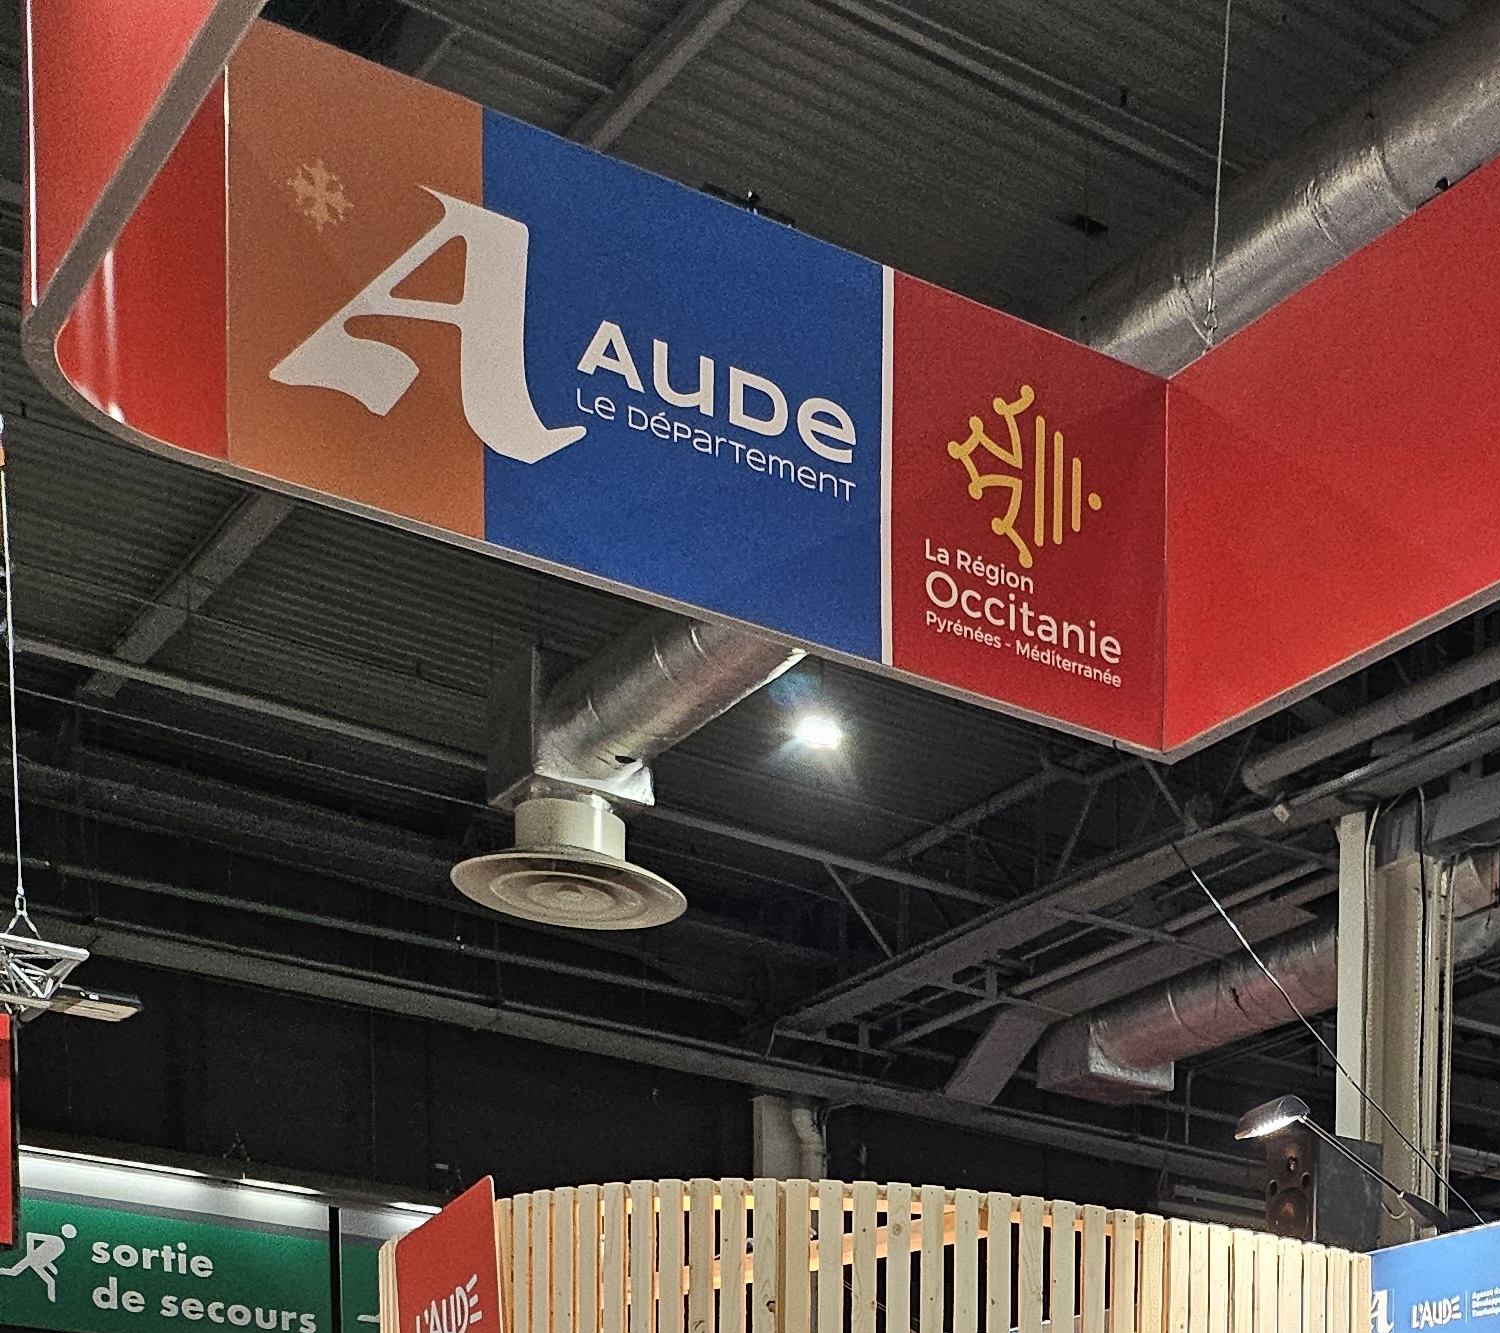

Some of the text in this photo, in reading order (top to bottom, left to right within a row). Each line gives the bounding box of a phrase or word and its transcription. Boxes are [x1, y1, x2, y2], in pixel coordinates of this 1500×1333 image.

[925, 538, 1034, 594] La Région
[925, 570, 1122, 665] Occitanie
[926, 611, 1122, 688] Pyrénées Méditerranée
[92, 1240, 214, 1278] sortie
[92, 1276, 146, 1314] de
[1410, 1295, 1462, 1330] L'AUDE
